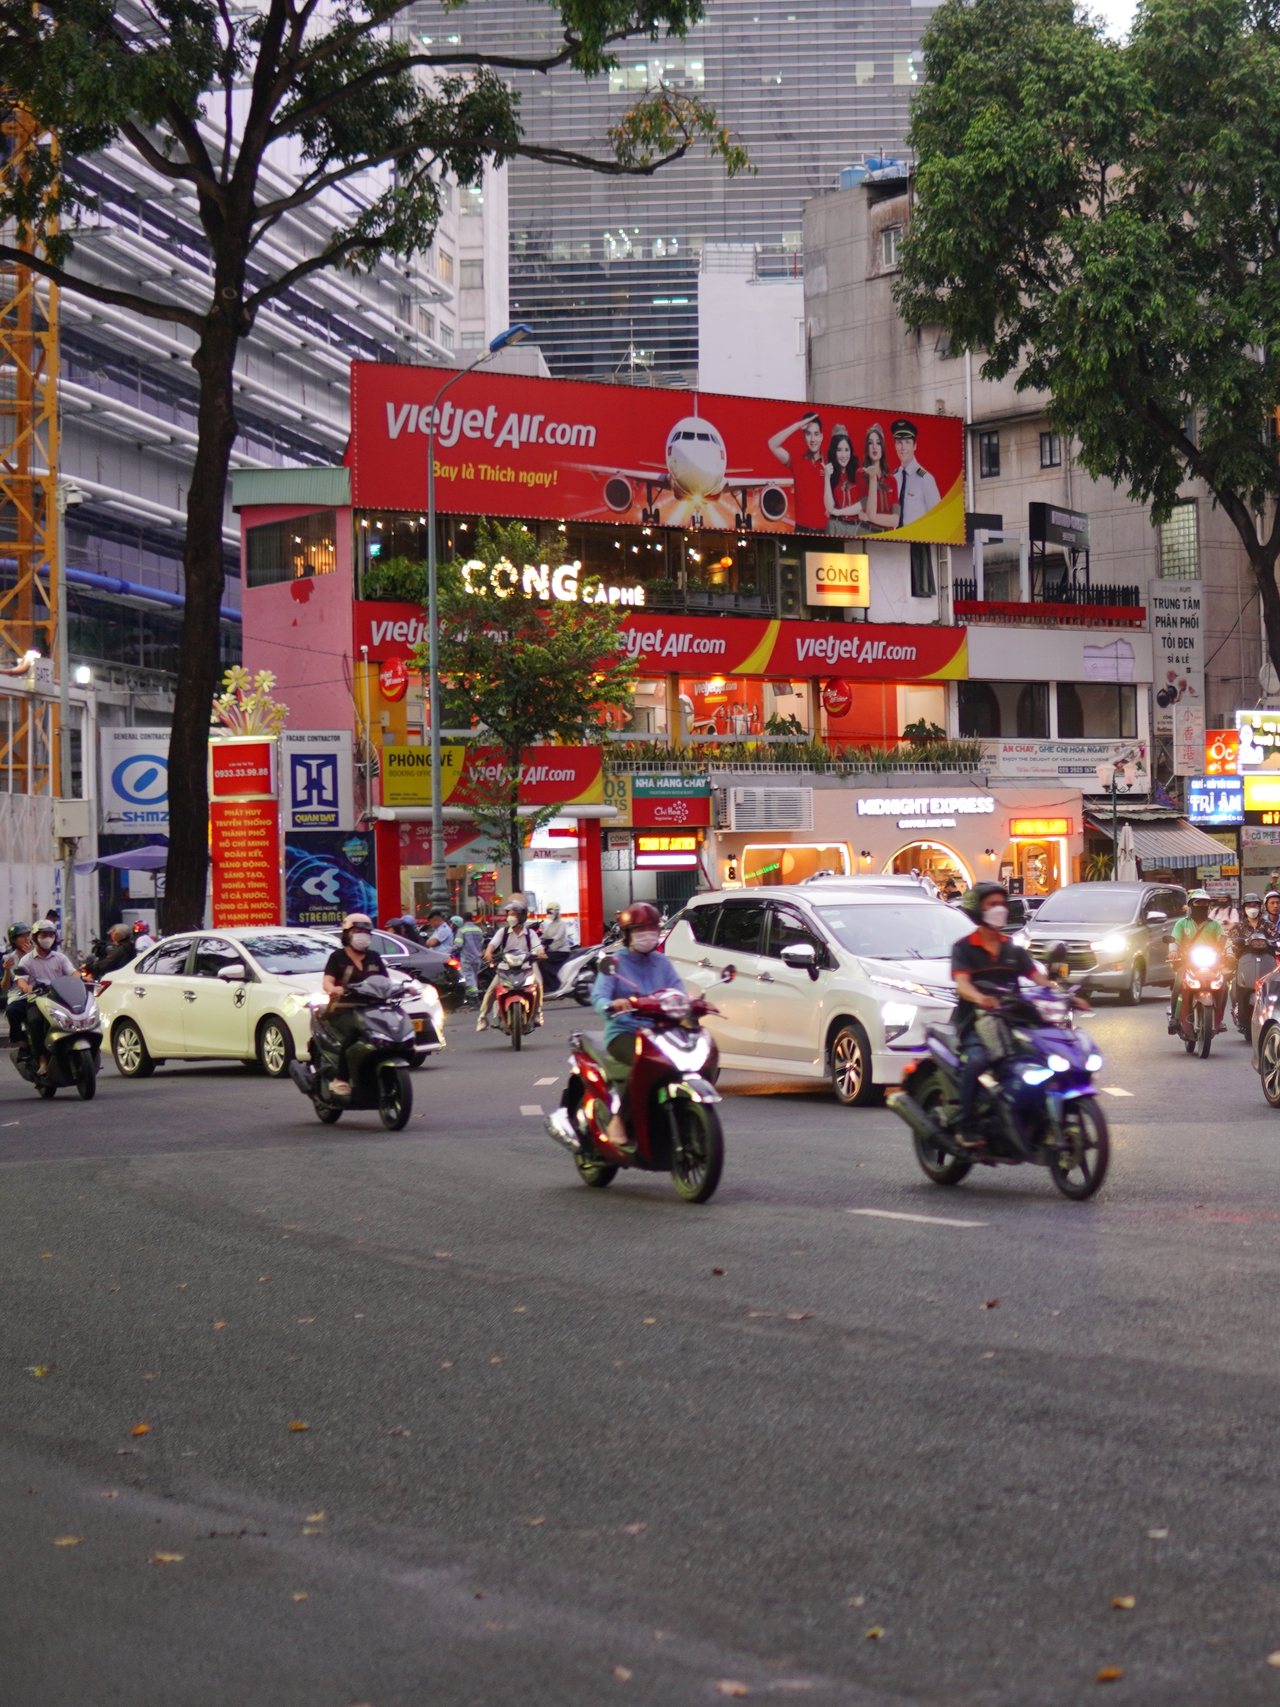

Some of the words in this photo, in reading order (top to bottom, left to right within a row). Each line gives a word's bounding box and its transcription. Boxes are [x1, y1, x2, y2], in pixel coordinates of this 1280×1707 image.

[432, 460, 458, 481] Bay
[462, 461, 474, 480] là
[478, 463, 515, 482] Thích
[518, 469, 558, 488] ngay!
[816, 565, 860, 585] CỘNG
[1153, 597, 1180, 610] TRUNG
[1182, 596, 1200, 610] TÂM
[1155, 614, 1178, 628] PHÂN
[1180, 612, 1199, 629] PHỐI
[1162, 632, 1176, 649] TỎI
[1177, 637, 1194, 649] ĐEN
[113, 733, 139, 741] GENERAL
[140, 733, 172, 741] CONTRACTO
[1015, 745, 1038, 755] CHAY,
[1070, 746, 1086, 754] HOA
[1211, 733, 1235, 761] Ốc
[440, 750, 454, 767] VÉ
[389, 769, 415, 777] BOOKING
[416, 769, 432, 777] OFFIC
[604, 780, 626, 798] 08
[684, 778, 706, 788] CHAY
[858, 799, 929, 816] MIDNIGHT
[930, 797, 995, 815] EXPRESS
[533, 850, 551, 858] ATM
